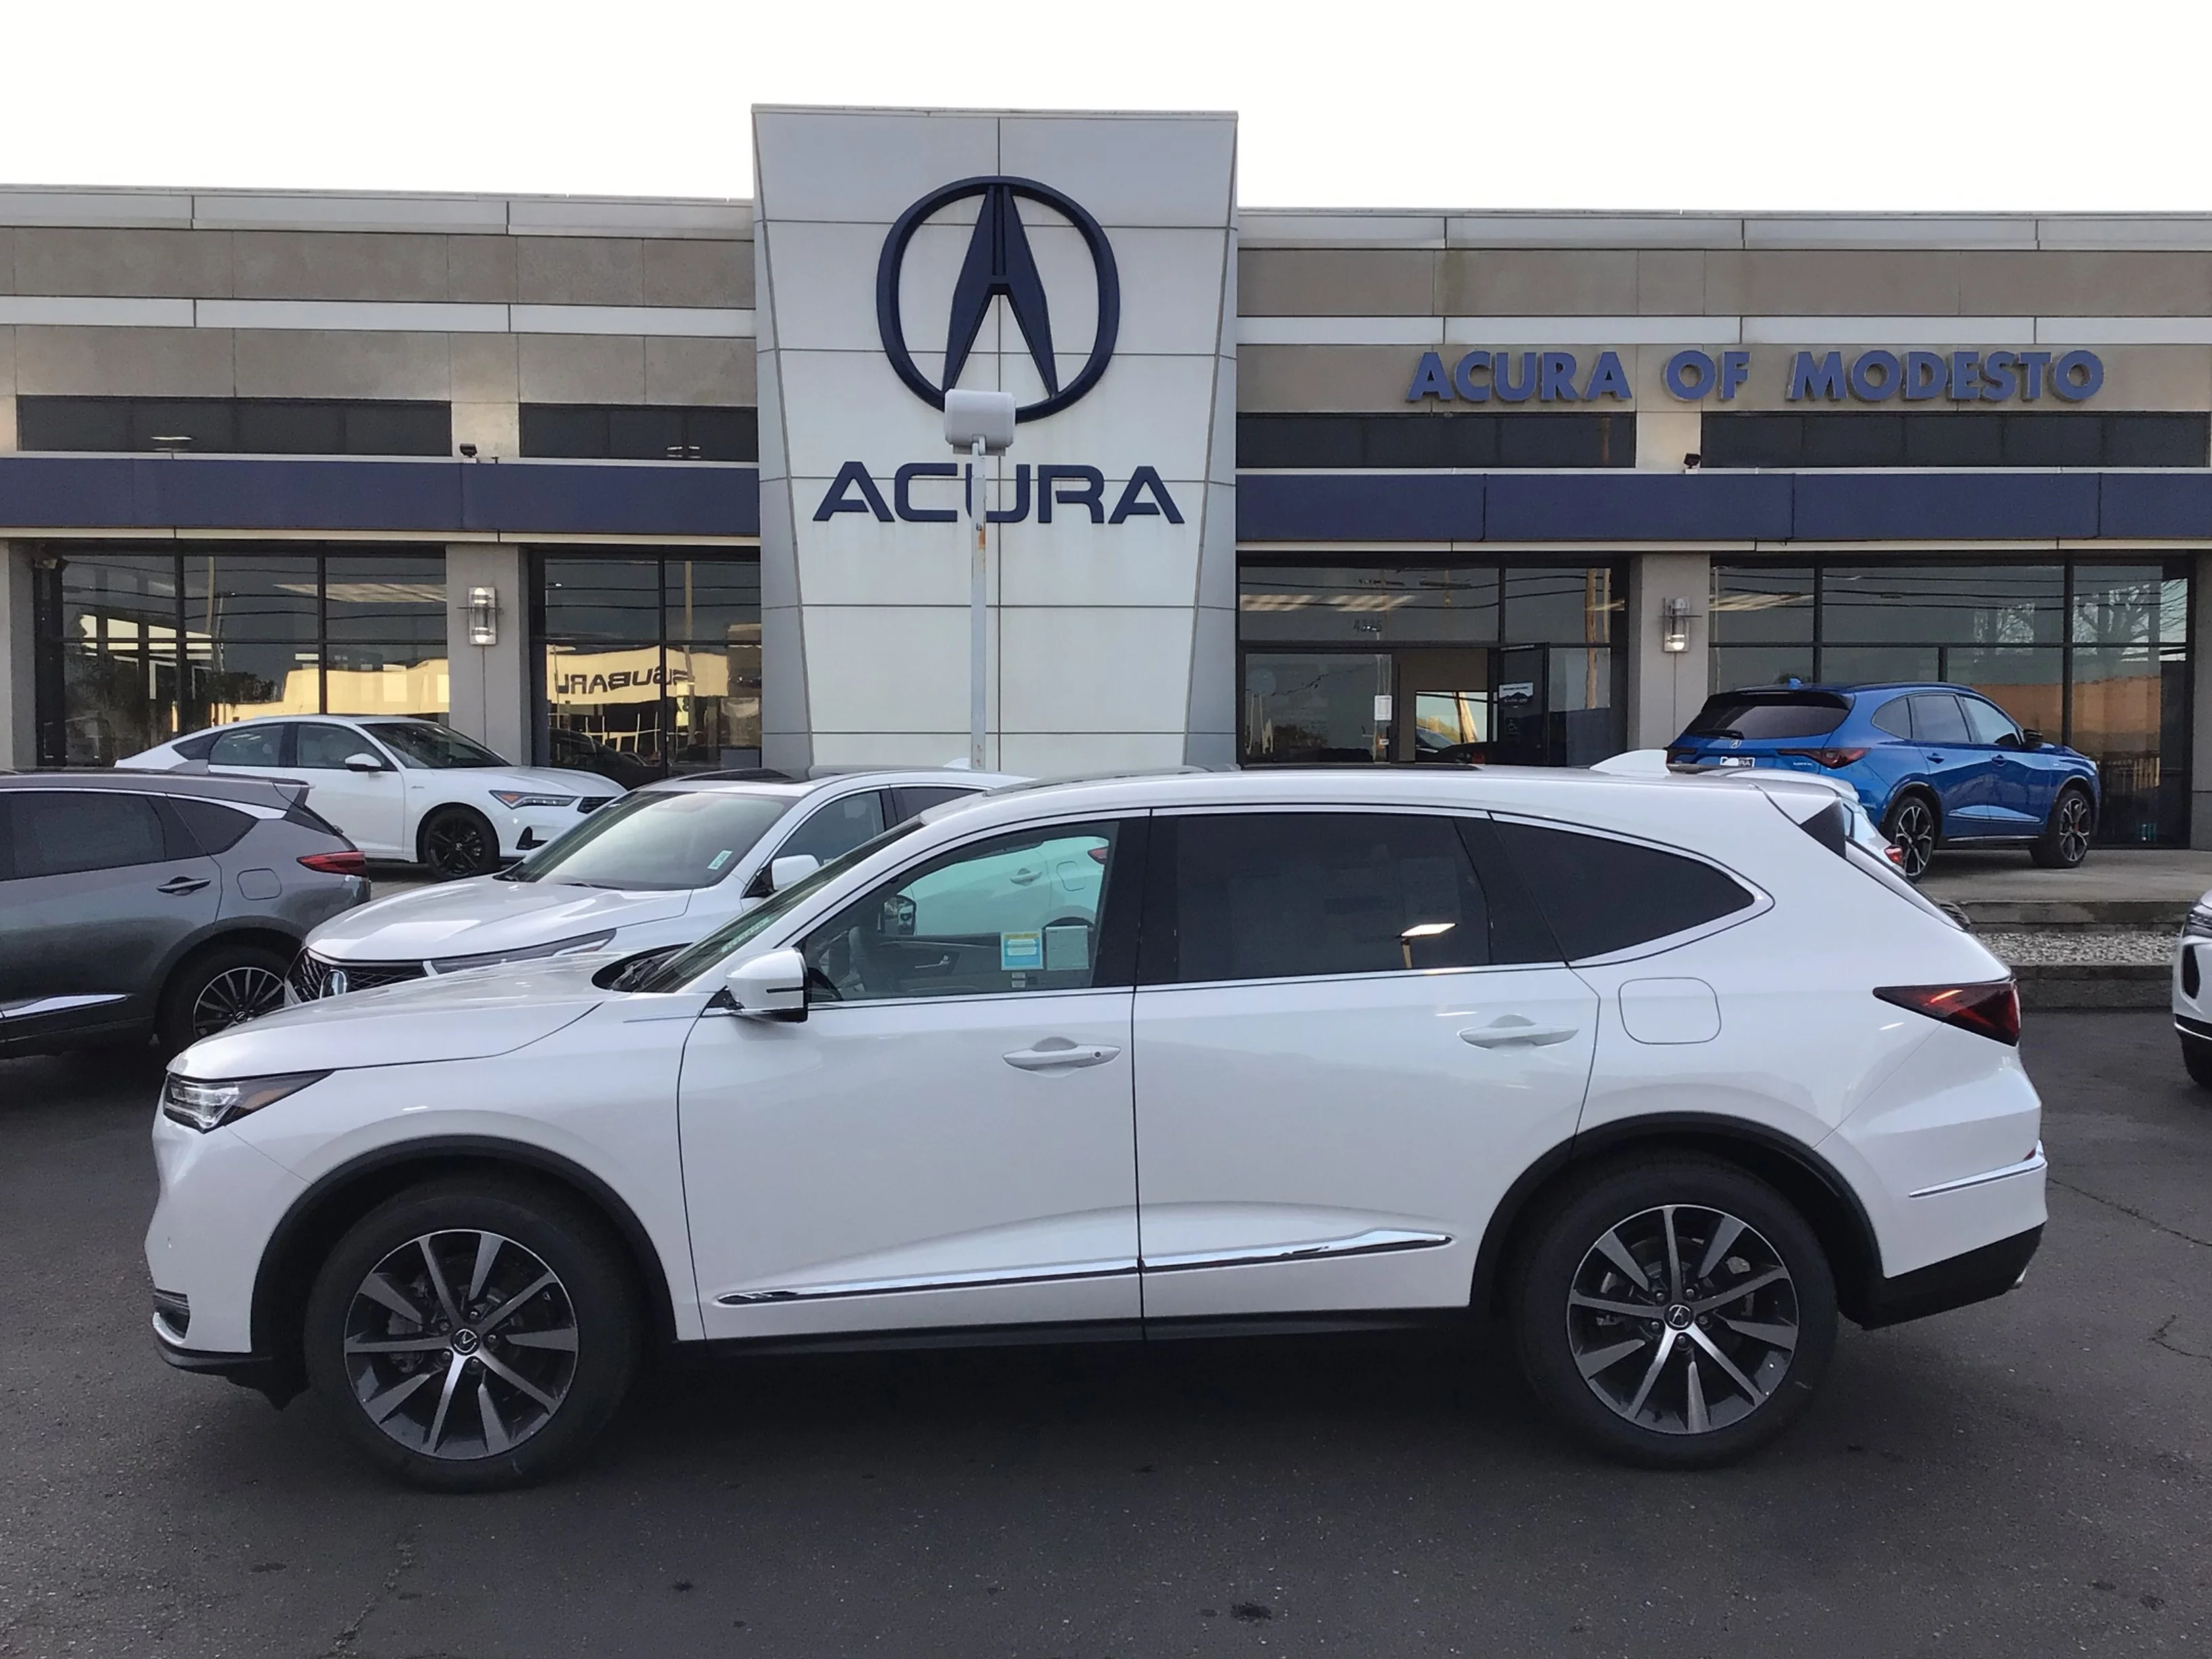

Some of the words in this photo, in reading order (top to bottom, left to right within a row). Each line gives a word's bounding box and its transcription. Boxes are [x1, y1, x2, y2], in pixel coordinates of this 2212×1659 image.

[1406, 350, 1633, 402] ACURA
[1665, 349, 1751, 401] OF
[1786, 349, 2105, 402] MODESTO
[813, 461, 1185, 524] ACURA
